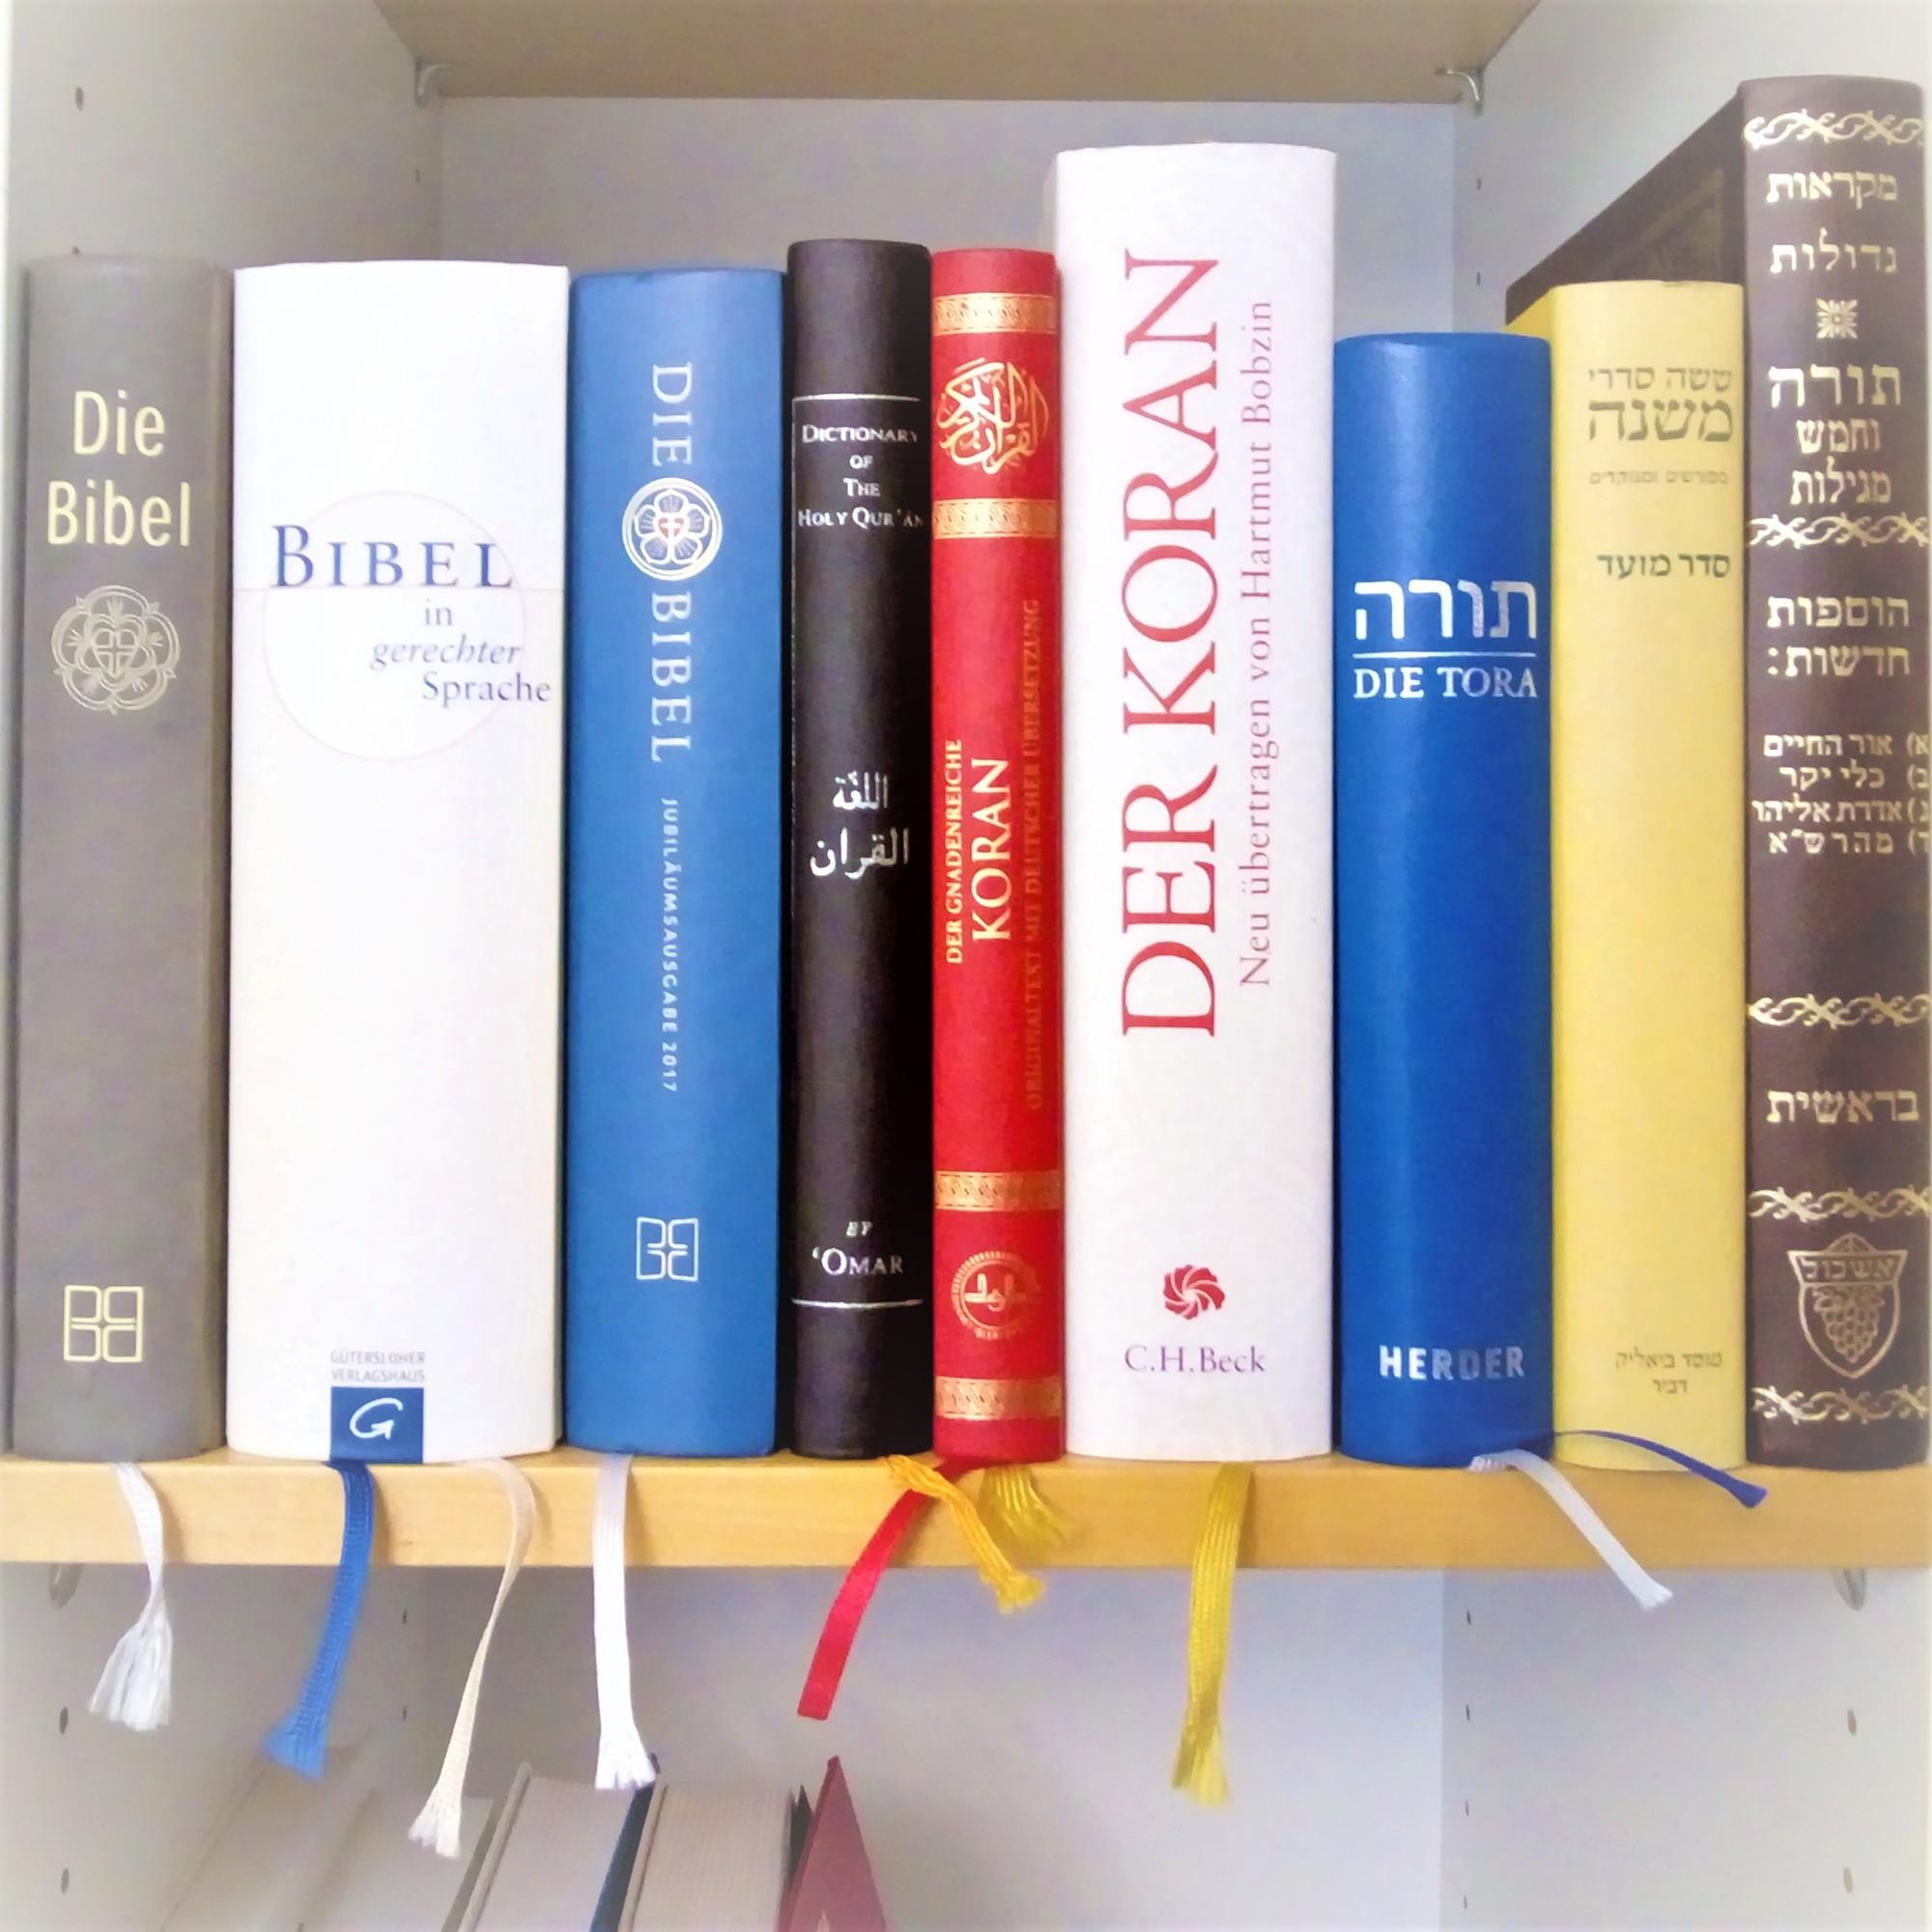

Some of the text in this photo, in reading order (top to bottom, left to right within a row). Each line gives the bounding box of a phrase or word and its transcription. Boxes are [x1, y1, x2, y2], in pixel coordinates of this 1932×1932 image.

[1766, 171, 1898, 210] מקראות
[1770, 227, 1897, 273] גדולות
[1769, 364, 1901, 408] תורה
[73, 390, 165, 457] Die
[1589, 399, 1732, 441] משנה
[1796, 418, 1881, 453] וחמש
[1790, 456, 1891, 504] מגילות
[47, 479, 189, 548] Bibel
[651, 362, 693, 762] DIE BIBEL
[1597, 554, 1730, 579] סדר מועד
[423, 599, 453, 626] in
[1354, 580, 1537, 639] תורה
[1767, 596, 1909, 628] הוספות
[369, 634, 523, 670] gerechter
[1121, 247, 1219, 1037] DER KORAN
[1238, 301, 1279, 986] Neu übertragen von Hartmut Bobzin
[422, 671, 552, 708] Sprache
[1353, 667, 1538, 698] DIE TORA
[1763, 734, 1843, 756] החיים
[1779, 766, 1832, 791] יקר
[1751, 792, 1831, 822] אליהו
[945, 739, 964, 964] DER GNADENREICHE
[971, 758, 1012, 942] KORAN
[661, 798, 682, 1092] JUBILÄUMSAUSGABE 2017
[1767, 1090, 1919, 1123] בראשית
[330, 1369, 425, 1382] VERLAGSHAUS
[1379, 1345, 1524, 1380] HERDER
